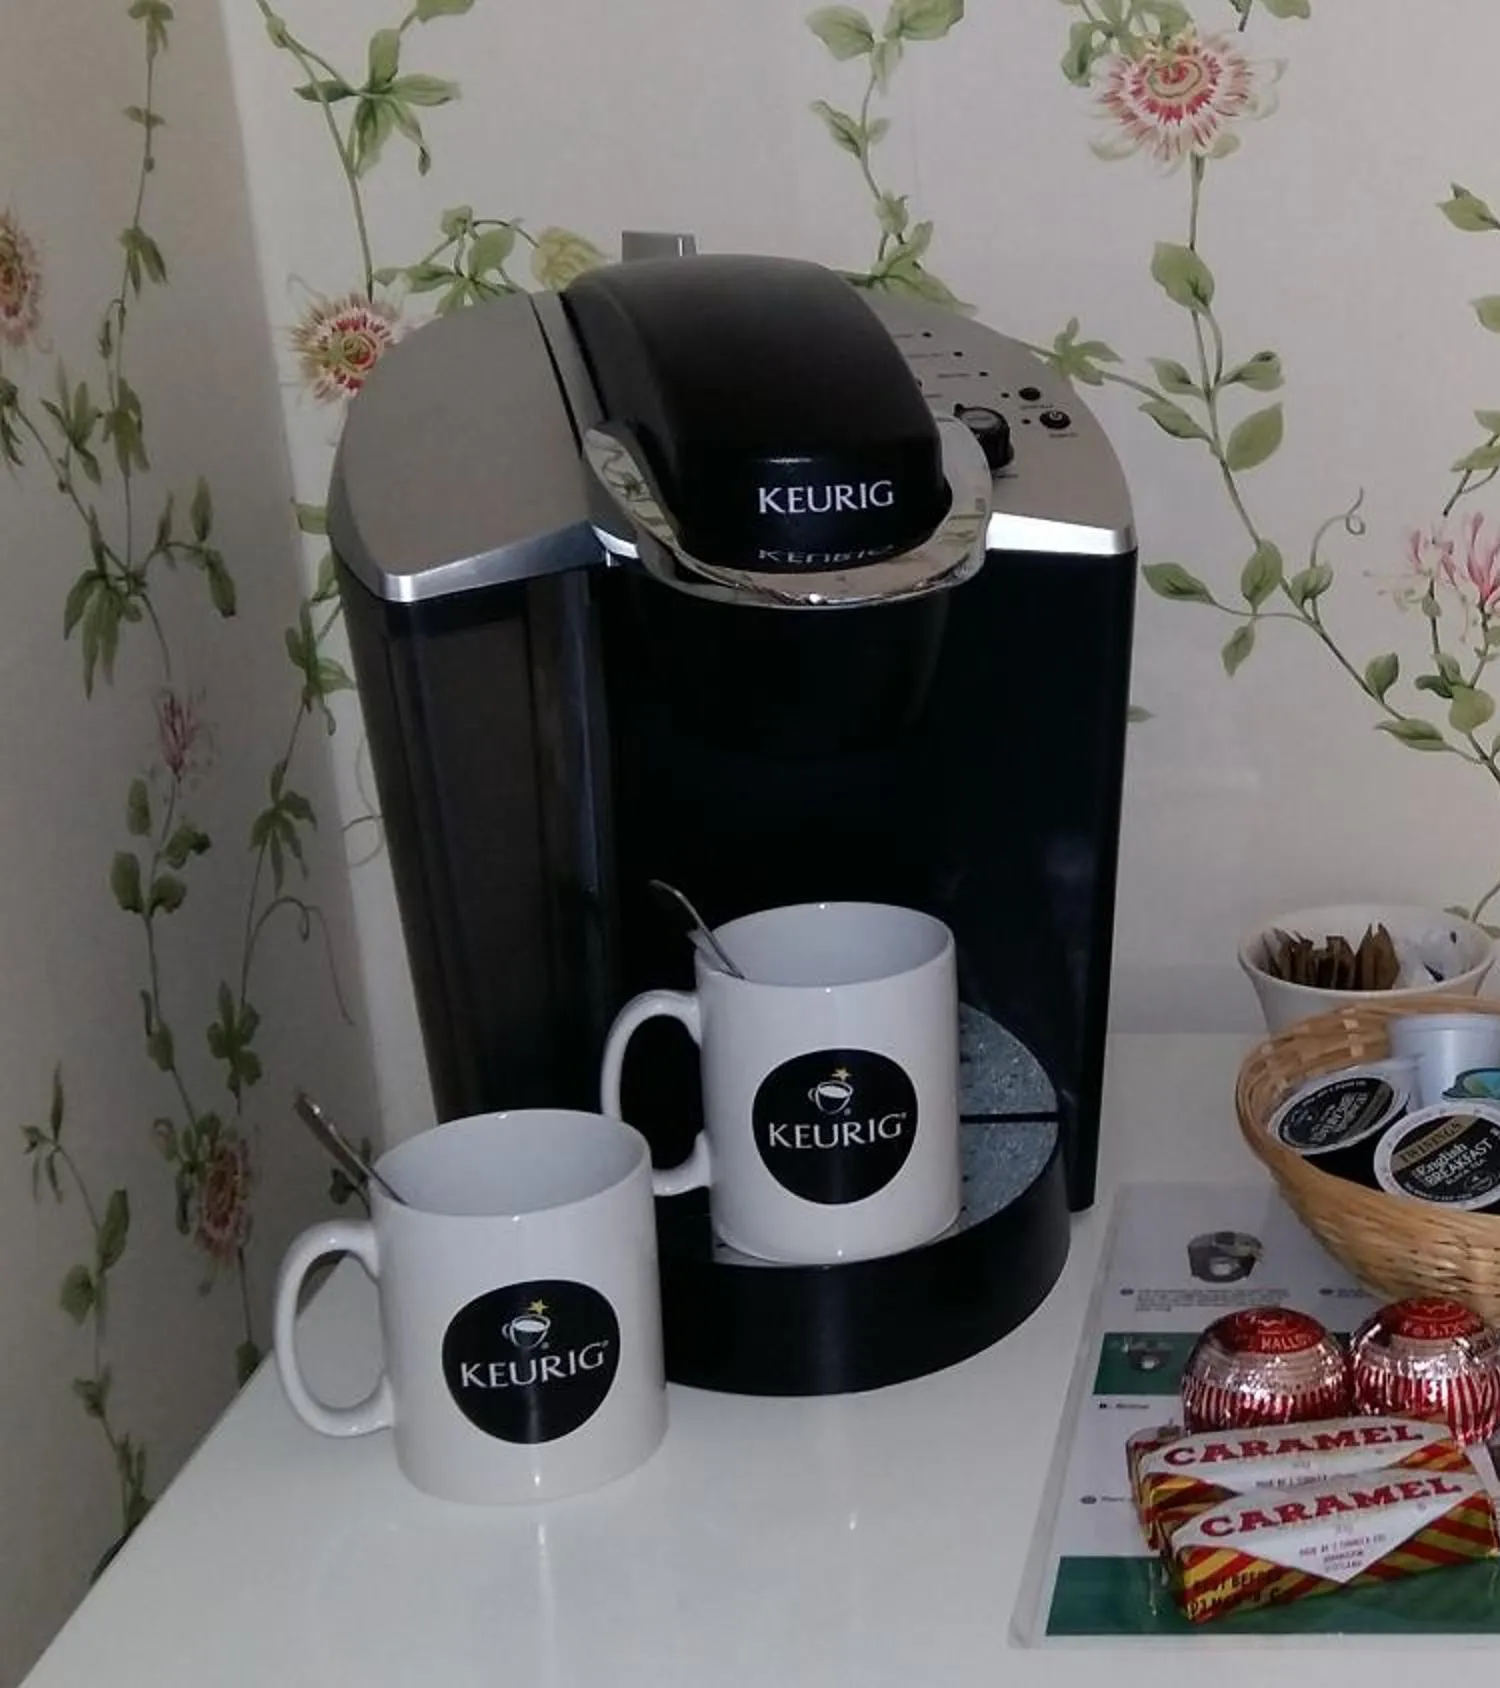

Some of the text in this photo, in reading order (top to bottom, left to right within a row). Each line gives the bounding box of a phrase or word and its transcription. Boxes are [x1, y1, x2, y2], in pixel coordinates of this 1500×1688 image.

[758, 480, 894, 515] KEURIG
[769, 1112, 903, 1151] KEURIG
[1423, 1137, 1493, 1187] BREAKFAST
[460, 1341, 605, 1390] KEURIG
[1163, 1424, 1424, 1466] CARAMEL
[1200, 1477, 1462, 1537] CARAMEL
